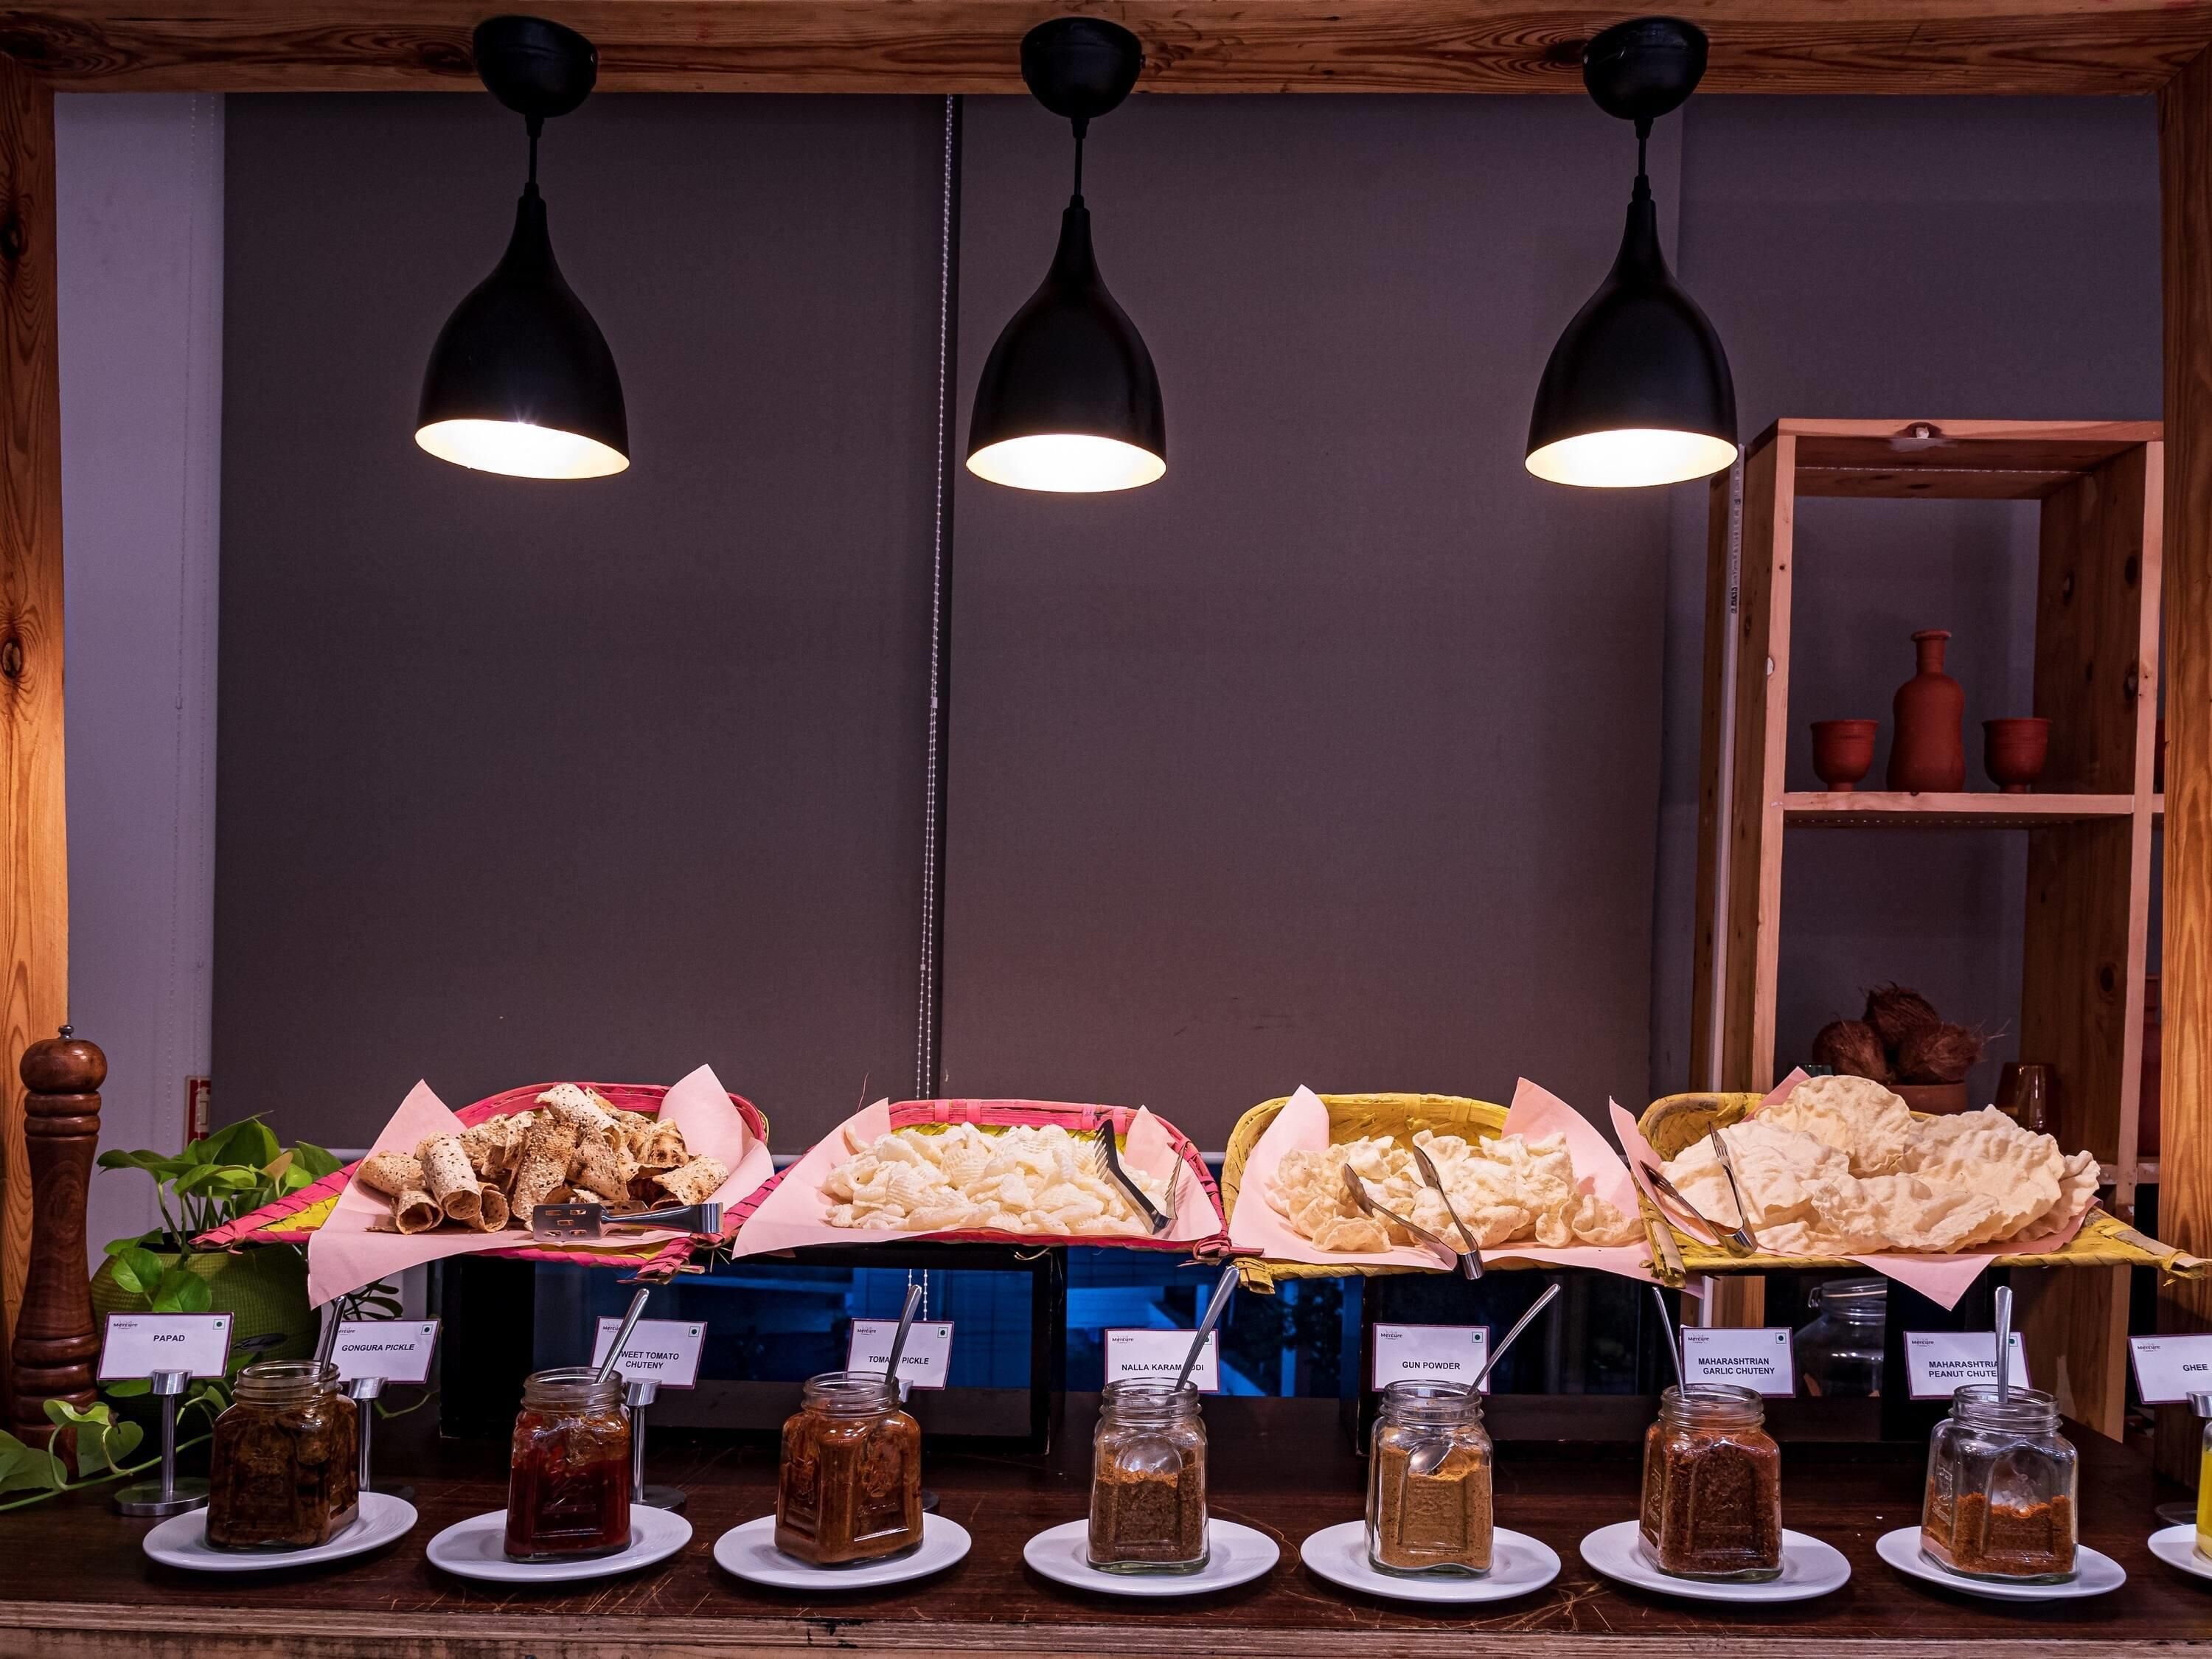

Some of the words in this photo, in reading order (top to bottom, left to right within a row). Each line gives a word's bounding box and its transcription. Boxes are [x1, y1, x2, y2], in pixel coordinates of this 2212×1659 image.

[620, 1350, 644, 1359] WEET
[645, 1352, 679, 1360] TOMATO
[869, 1355, 891, 1363] TOMA
[902, 1357, 930, 1365] PICKLE
[1928, 1360, 1998, 1368] MAHARASHTRIA
[625, 1360, 664, 1369] CHUTENY
[1422, 1362, 1461, 1370] POWDER
[2183, 1363, 2209, 1371] GHEE
